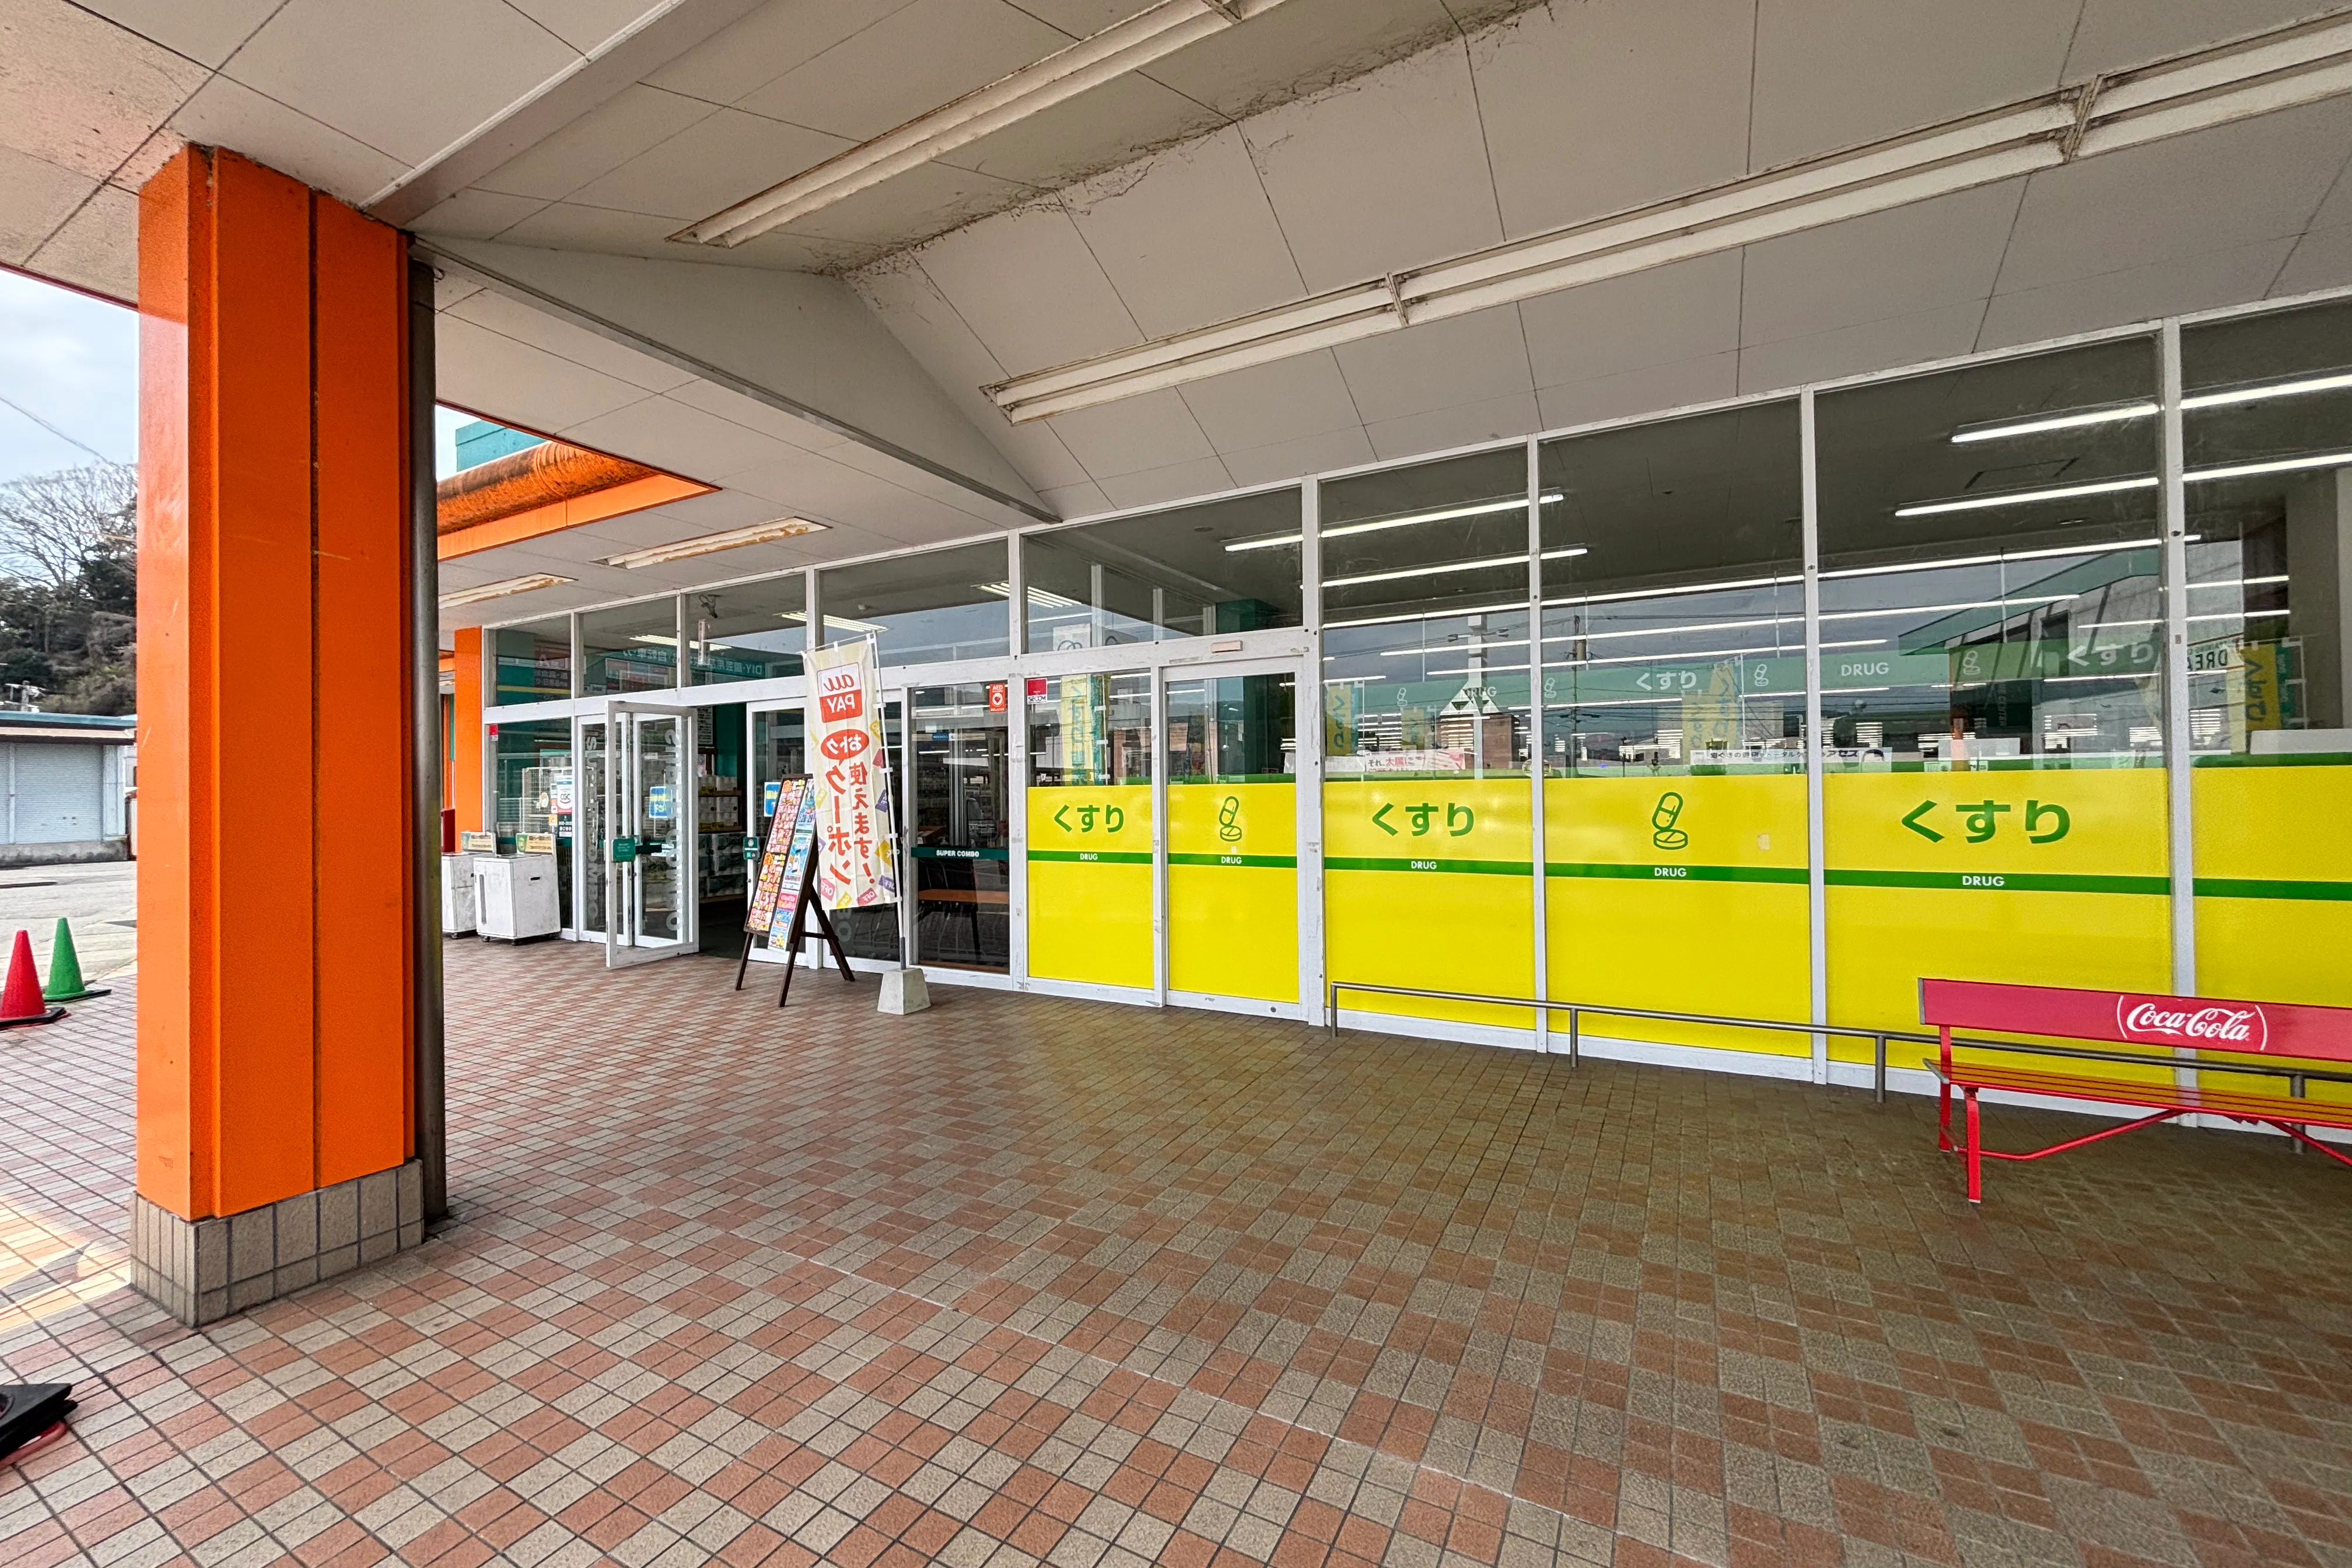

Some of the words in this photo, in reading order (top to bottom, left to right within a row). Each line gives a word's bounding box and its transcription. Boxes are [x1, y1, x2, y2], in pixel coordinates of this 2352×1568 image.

[1840, 662, 1890, 677] DRUG
[1636, 670, 1697, 691] くすり
[1465, 687, 1497, 698] DRUG
[1054, 804, 1125, 833] くすり
[1371, 802, 1475, 837] くすり
[1901, 800, 2071, 844] くすり
[1221, 856, 1242, 864] DRUG
[1410, 861, 1437, 870] DRUG
[1654, 867, 1687, 877] DRUG
[1962, 875, 2006, 887] DRUG
[2126, 1003, 2256, 1041] Coca-Cola
